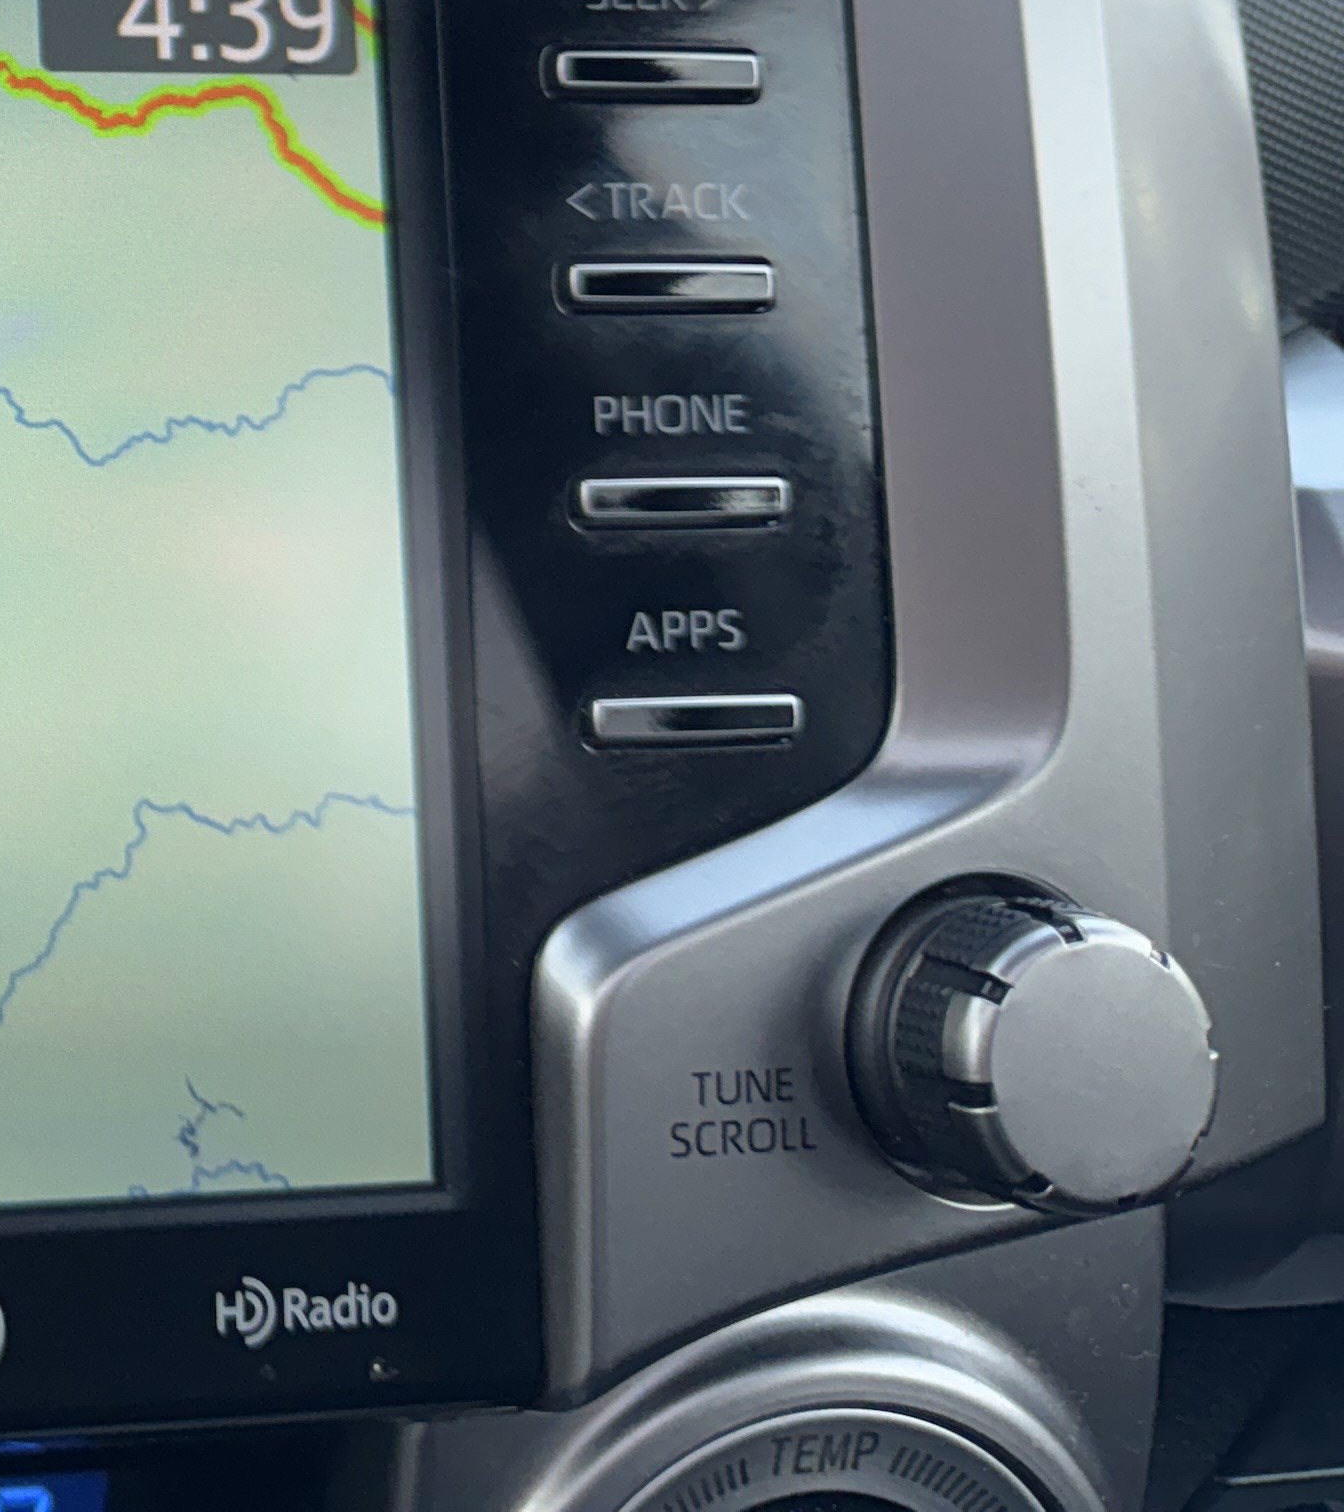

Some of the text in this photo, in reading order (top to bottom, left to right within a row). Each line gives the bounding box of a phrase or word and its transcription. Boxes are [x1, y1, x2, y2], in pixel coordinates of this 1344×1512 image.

[602, 182, 750, 221] TRACK
[594, 395, 749, 435] PHONE
[625, 609, 747, 653] APPS
[691, 1067, 794, 1107] TUNE
[669, 1116, 817, 1158] SCROLL
[215, 1278, 398, 1345] HD Radio
[769, 1431, 881, 1478] TEMP
